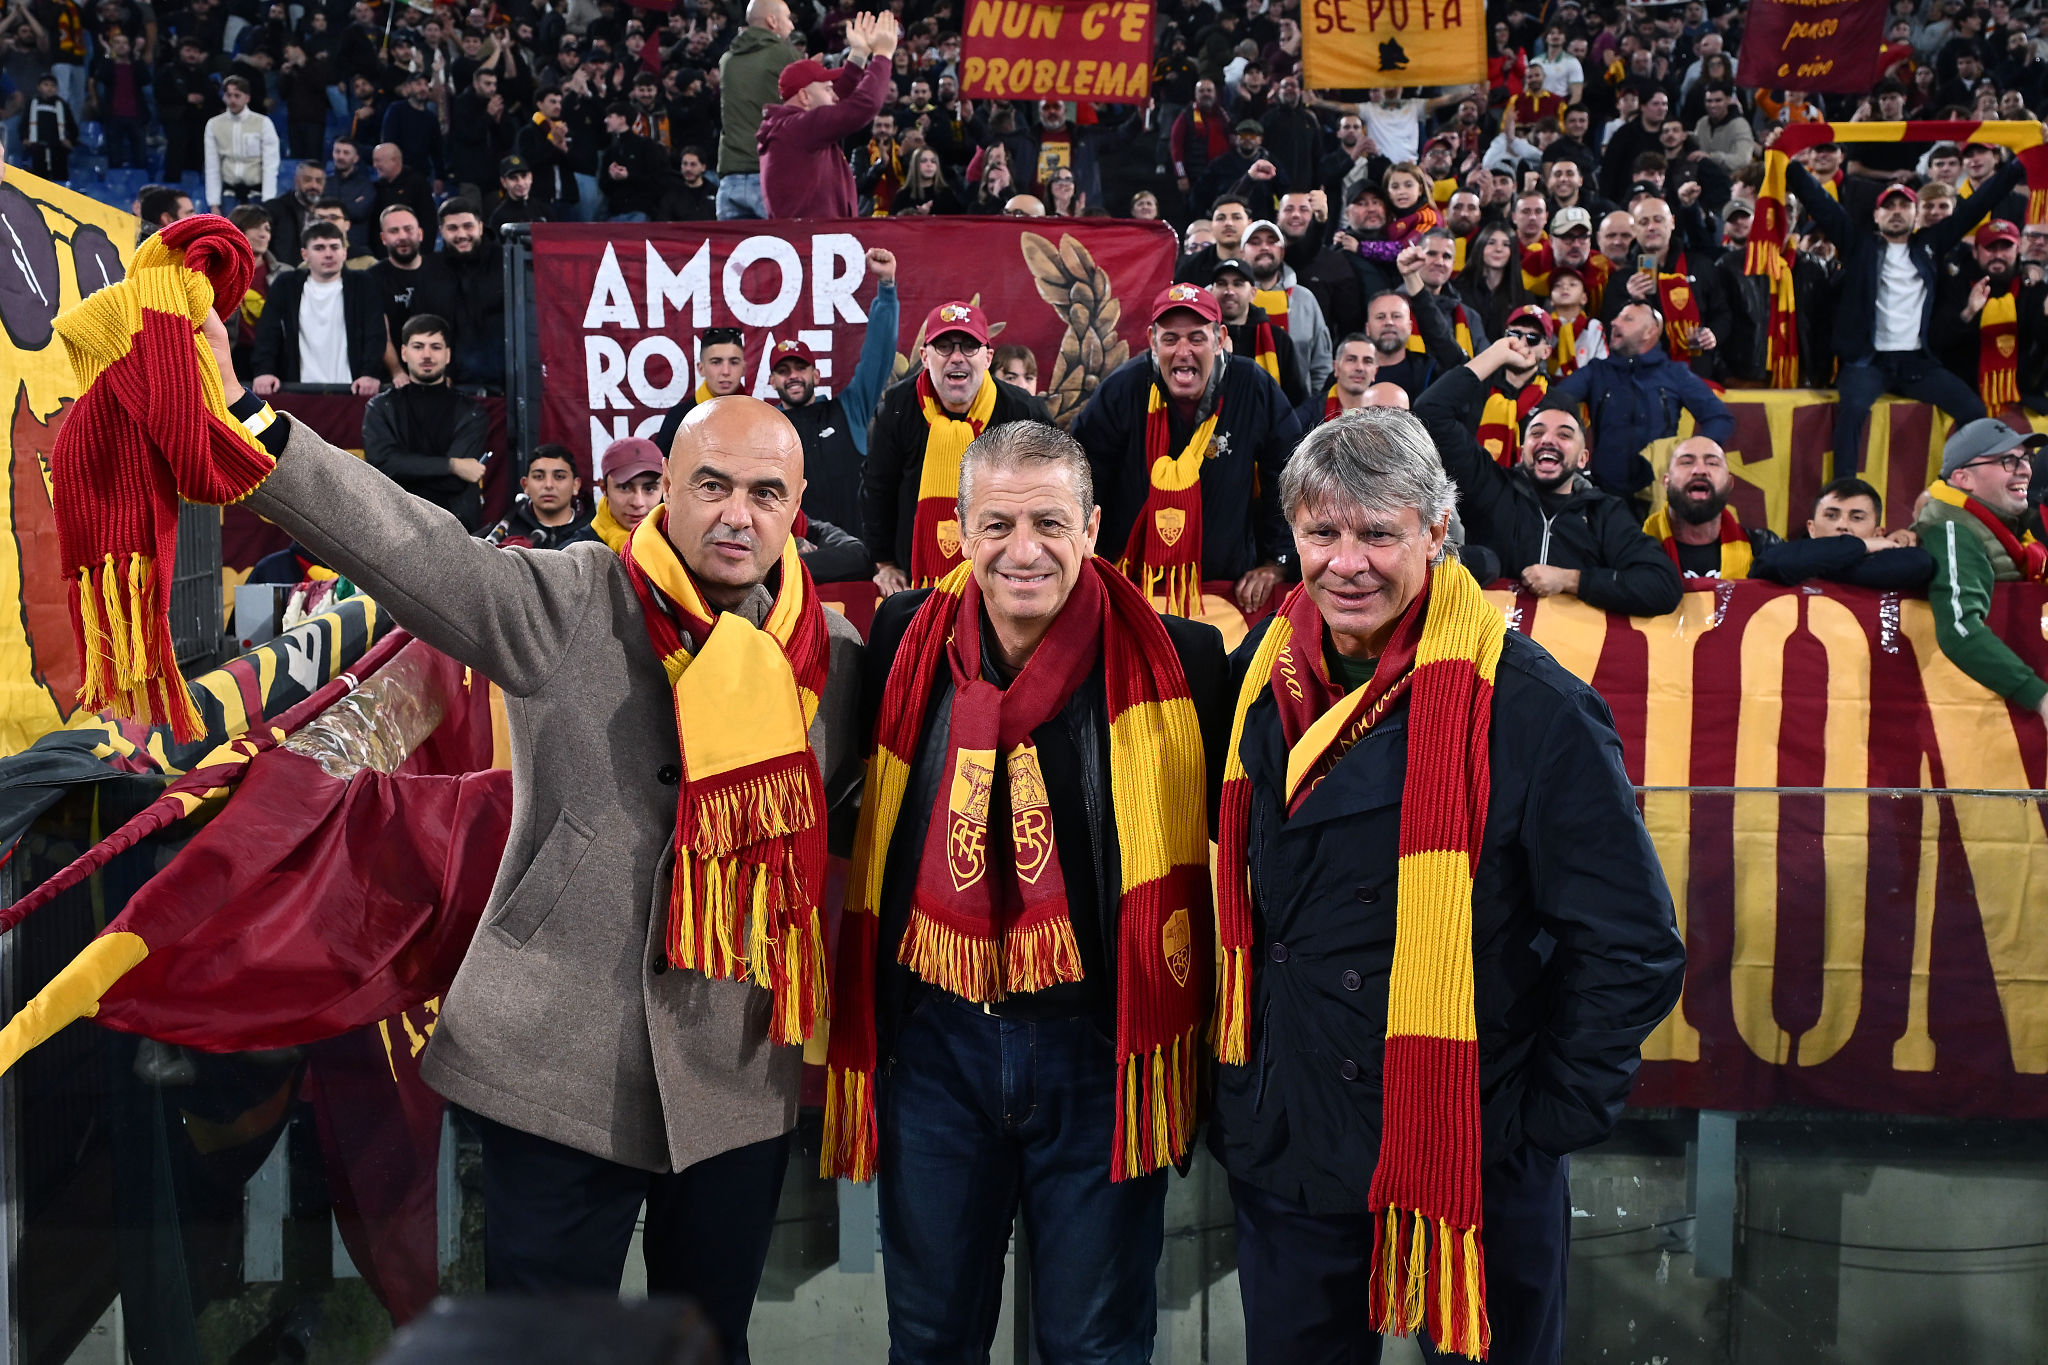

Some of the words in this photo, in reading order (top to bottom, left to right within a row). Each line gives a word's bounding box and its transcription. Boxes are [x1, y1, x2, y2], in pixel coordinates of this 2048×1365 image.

[967, 1, 1064, 39] NUN
[1314, 0, 1355, 34] SE
[961, 56, 1149, 98] PROBLEMA
[582, 233, 869, 329] AMOR
